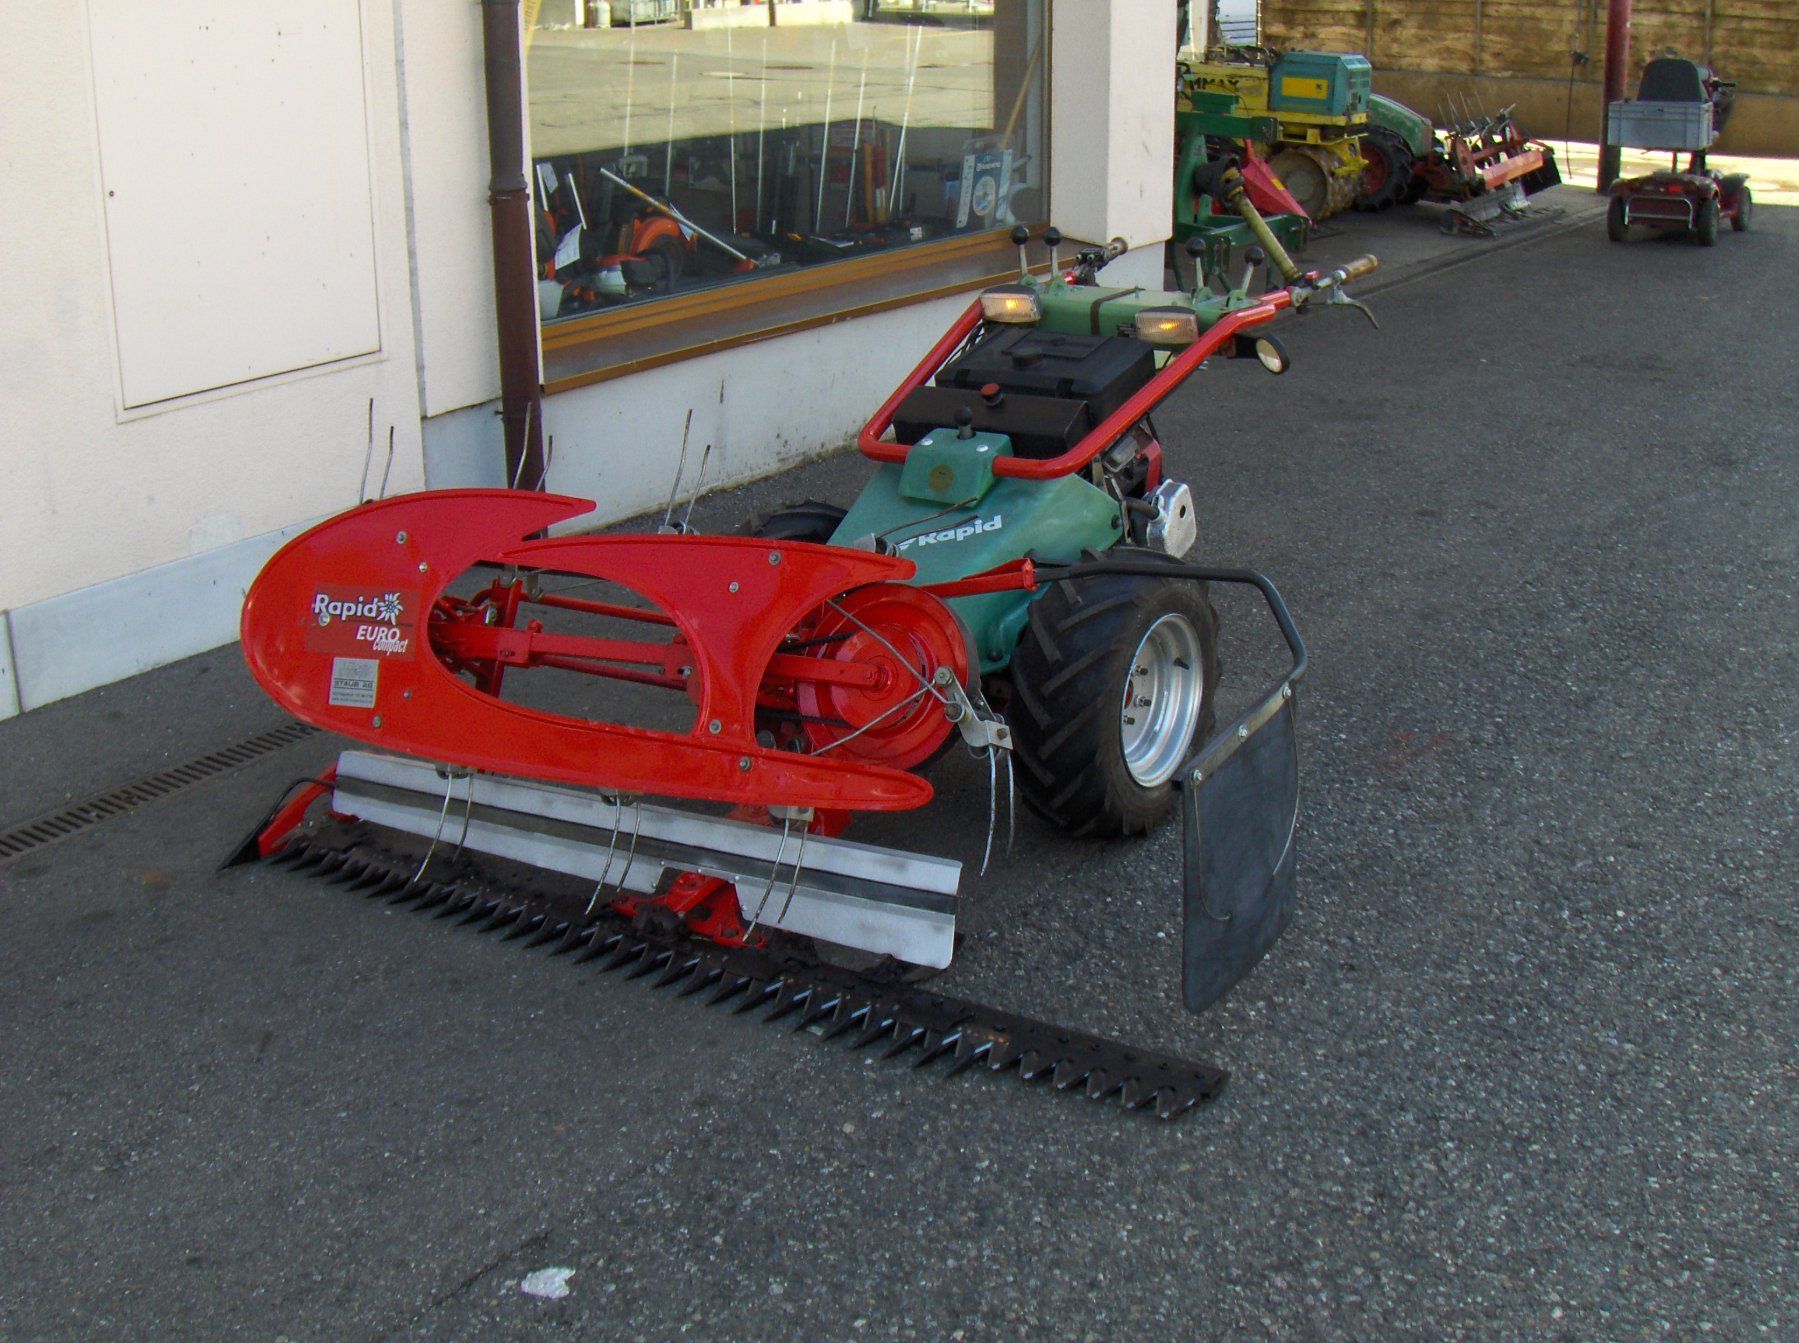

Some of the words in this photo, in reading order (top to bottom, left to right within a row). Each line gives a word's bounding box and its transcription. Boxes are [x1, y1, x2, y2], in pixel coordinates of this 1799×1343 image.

[314, 593, 379, 621] Rapid
[356, 625, 400, 642] EURO
[372, 639, 409, 656] compact
